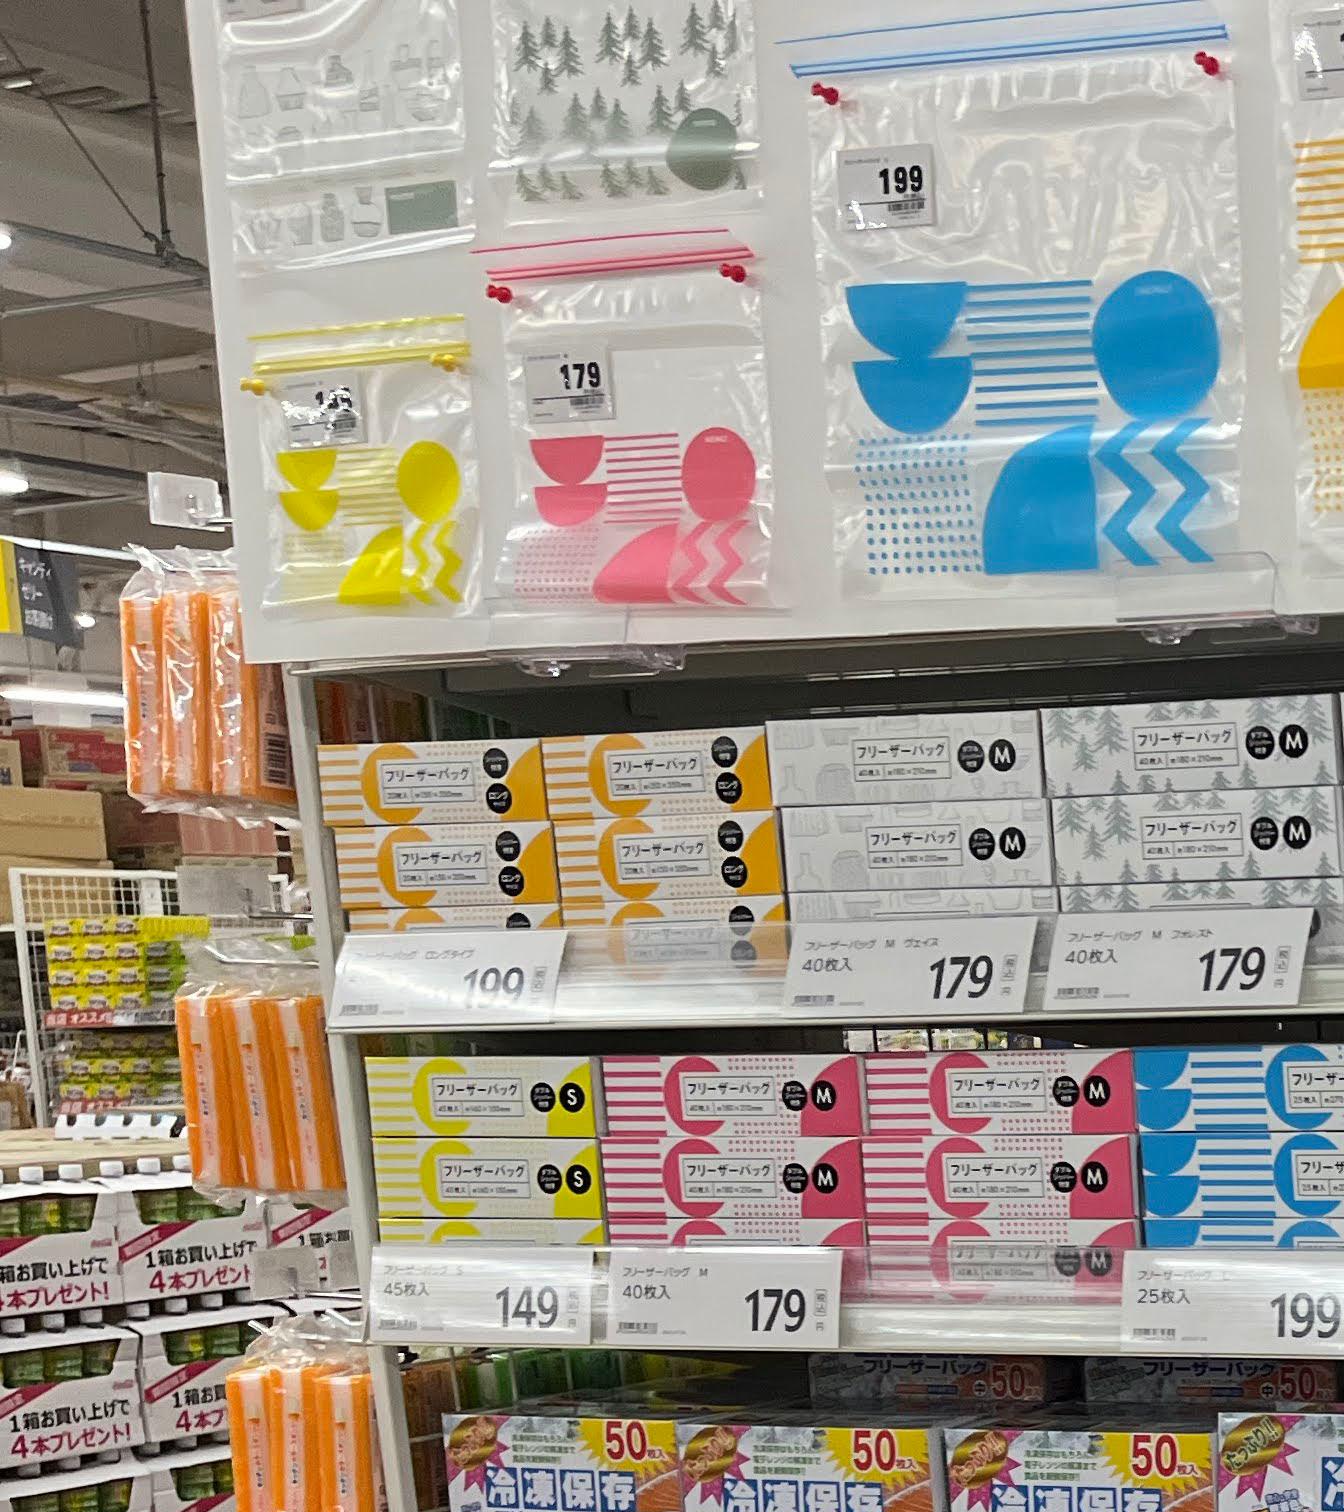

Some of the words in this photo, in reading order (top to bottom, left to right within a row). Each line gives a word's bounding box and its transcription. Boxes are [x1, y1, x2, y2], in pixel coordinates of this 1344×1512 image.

[878, 164, 924, 195] 199
[559, 361, 601, 390] 179
[1137, 727, 1233, 747] フリーザーバッグ
[1284, 731, 1304, 752] M
[855, 742, 947, 760] フリーザーバッグ
[994, 747, 1011, 766] M
[611, 755, 698, 775] フリーザーバッグ
[401, 849, 482, 867] フリーザーバッグ
[801, 956, 853, 974] 40枚入
[1064, 948, 1119, 966] 40枚入
[928, 953, 995, 1001] 179
[1198, 945, 1267, 993] 179
[464, 966, 525, 1003] 199
[435, 1082, 519, 1098] フリーザーバッグ
[685, 1080, 772, 1097] フリーザーバッグ
[953, 1077, 1042, 1093] フリーザーバッグ
[1088, 1083, 1107, 1101] M
[566, 1088, 579, 1106] S
[815, 1087, 834, 1105] M
[383, 1281, 430, 1298] 45枚入
[622, 1282, 673, 1301] 40枚入
[1137, 1287, 1191, 1305] 25枚入
[495, 1285, 561, 1330] 149
[745, 1287, 807, 1334] 179
[1270, 1292, 1342, 1340] 199
[10, 1399, 131, 1433] 1箱お買い上げで
[11, 1422, 132, 1459] 4本プレゼント!
[606, 1420, 667, 1461] 50枚入
[853, 1430, 917, 1472] 50枚入
[1131, 1434, 1200, 1478] 50枚入
[487, 1468, 636, 1512] 冷凍保存
